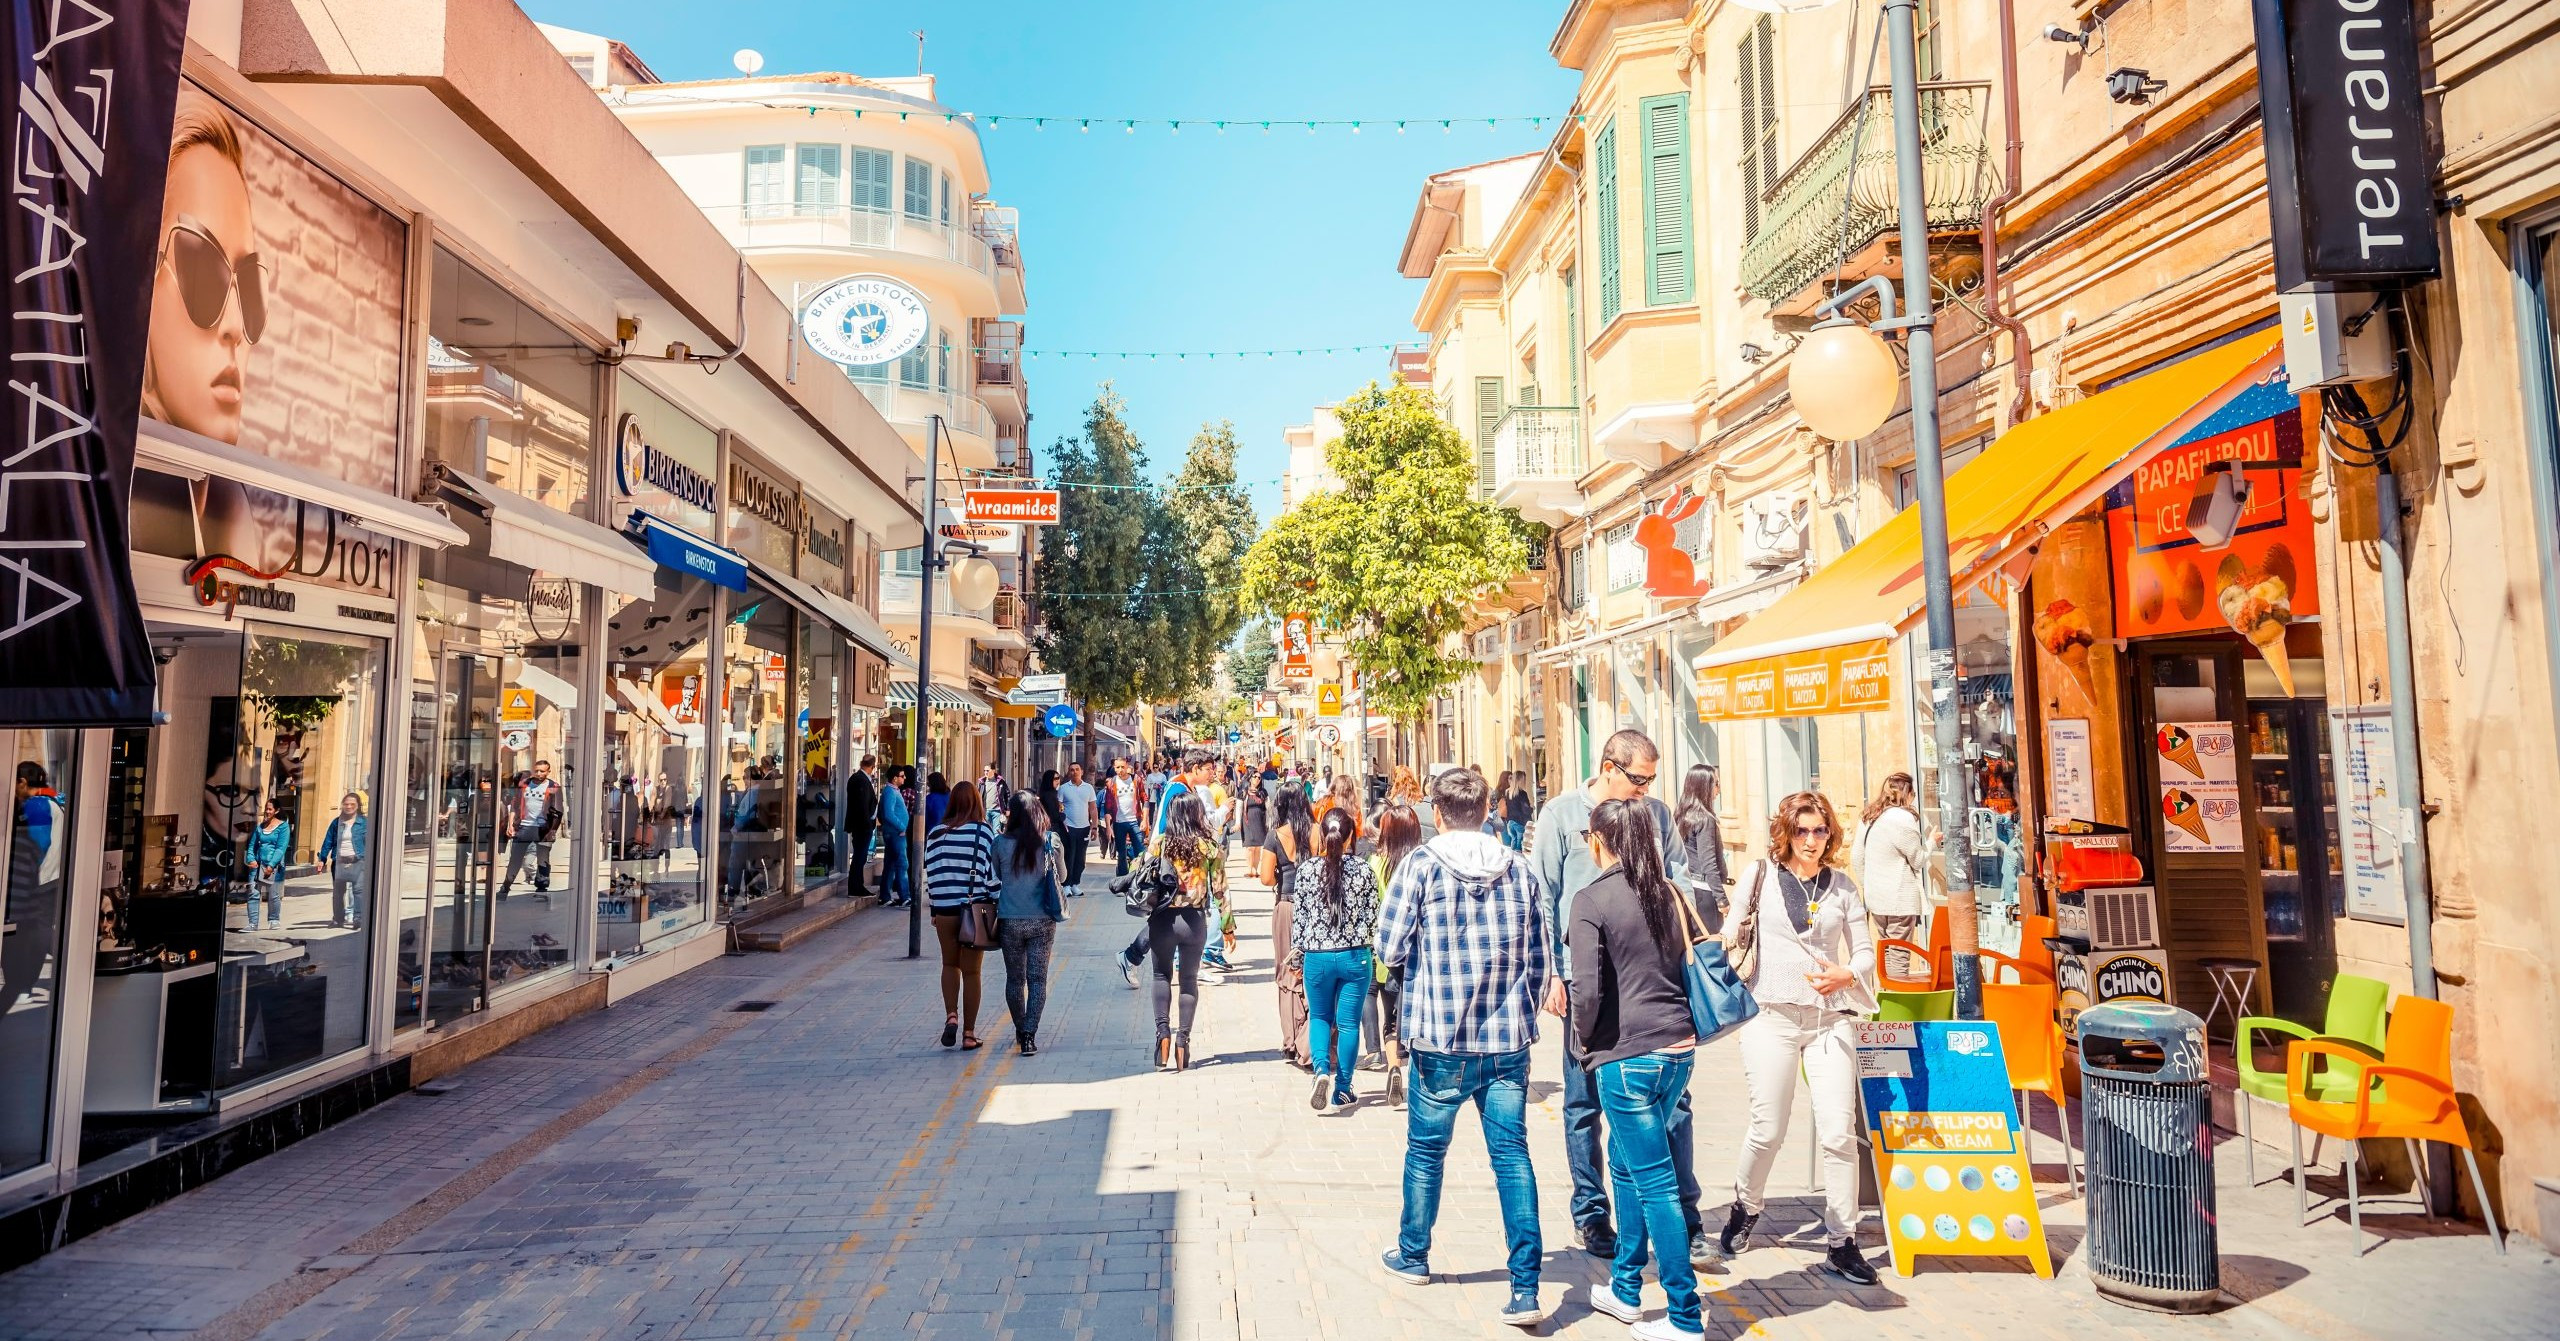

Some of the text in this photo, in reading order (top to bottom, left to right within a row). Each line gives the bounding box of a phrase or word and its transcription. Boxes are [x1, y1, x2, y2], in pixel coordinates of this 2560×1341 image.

[811, 283, 920, 318] BIRKENSTOCK
[810, 328, 920, 362] ORTHOPAEDIC SHOES
[0, 312, 93, 641] ITALIA
[648, 449, 719, 513] BIRKENSTOCK
[735, 465, 804, 534] MOCASSINO
[966, 497, 1057, 516] Avraamides
[940, 524, 1008, 537] WALKERLAND
[2156, 503, 2182, 535] ICE
[287, 500, 389, 590] Dior
[685, 549, 717, 575] BIRKENSTOCK
[1286, 667, 1311, 676] KFC
[2074, 838, 2101, 846] SMALL
[2110, 959, 2146, 970] ORIGINAL
[2059, 965, 2088, 994] CHINO
[2100, 970, 2162, 998] CHINO
[1855, 1022, 1913, 1031] ICE CREAM
[1860, 1032, 1871, 1044] €
[1903, 1134, 1993, 1148] ICE CREAM
